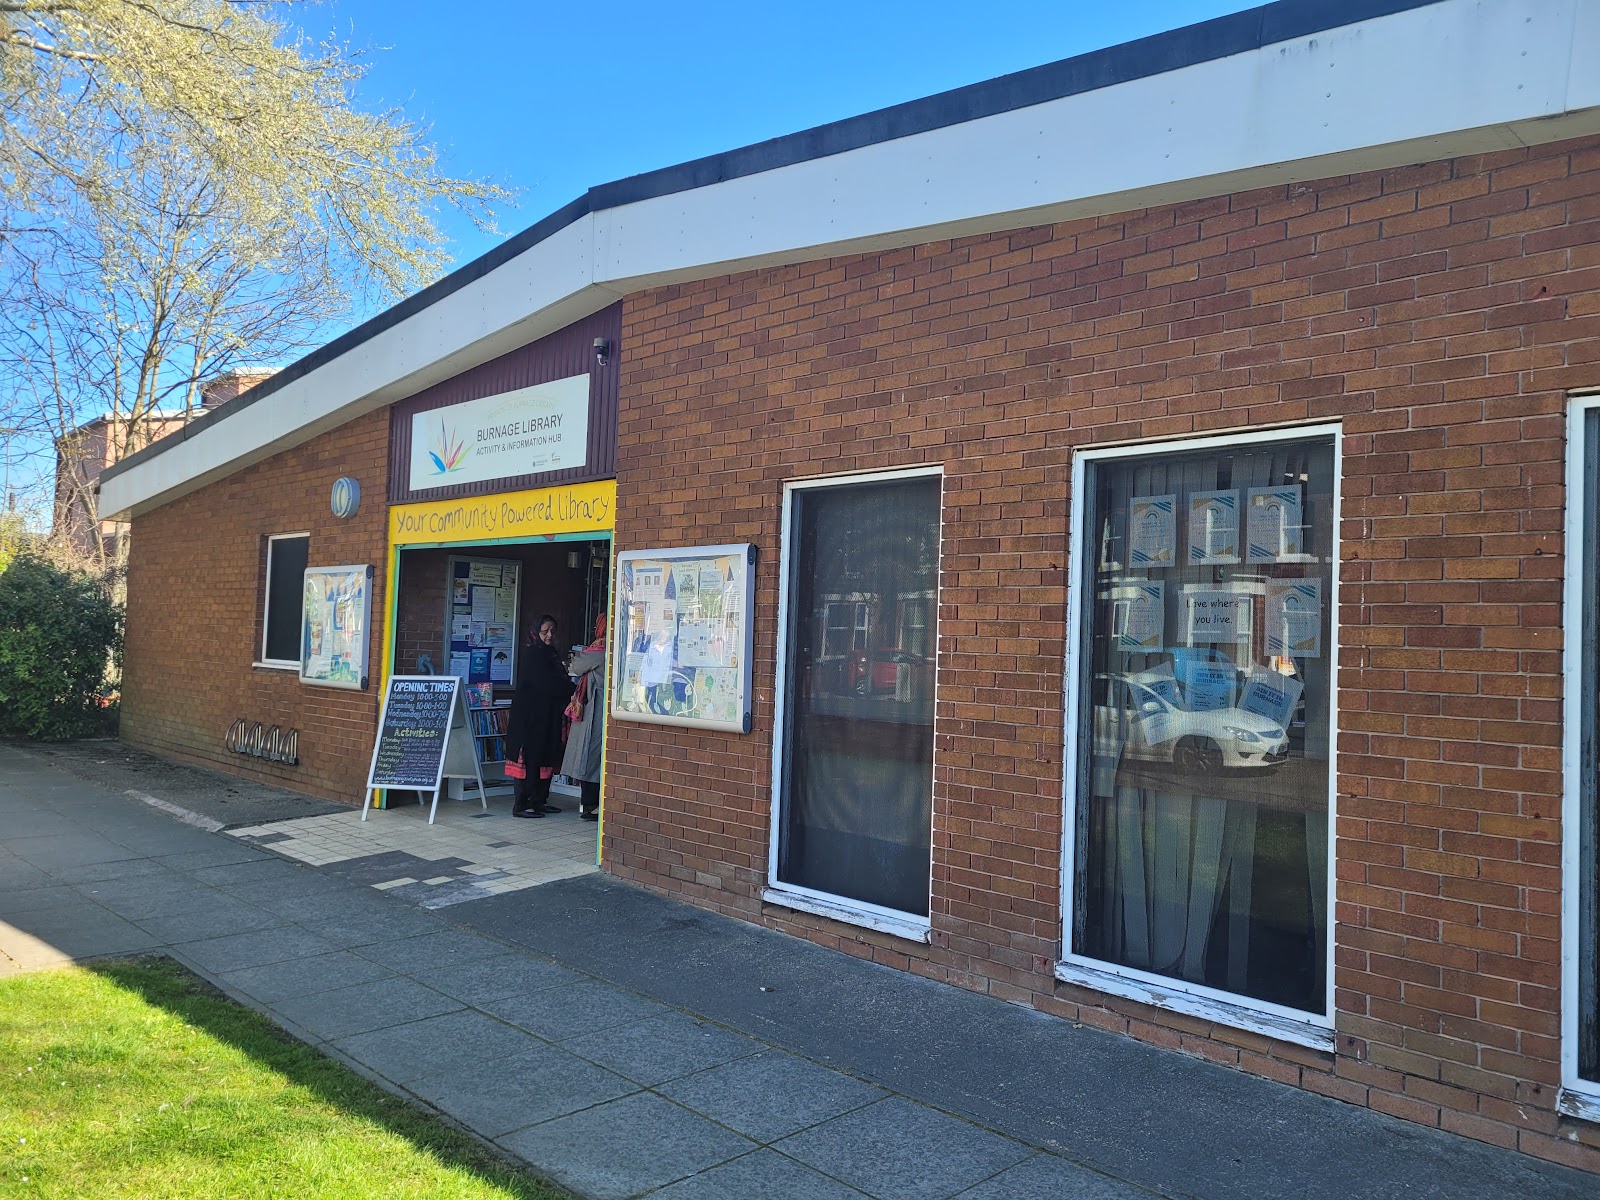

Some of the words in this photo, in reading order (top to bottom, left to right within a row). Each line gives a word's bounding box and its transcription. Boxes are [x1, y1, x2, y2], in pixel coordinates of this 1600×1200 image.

[477, 422, 520, 442] BURNAGE
[522, 413, 563, 434] LIBRARY
[476, 444, 500, 456] ACTIVITY
[501, 443, 506, 451] &
[506, 435, 547, 451] INFORMATION
[548, 433, 562, 443] HUB
[397, 510, 428, 534] Your
[501, 494, 553, 523] Powered
[1210, 597, 1240, 608] where
[1195, 615, 1211, 624] you
[1213, 614, 1233, 624] live.
[430, 682, 455, 692] TIMES
